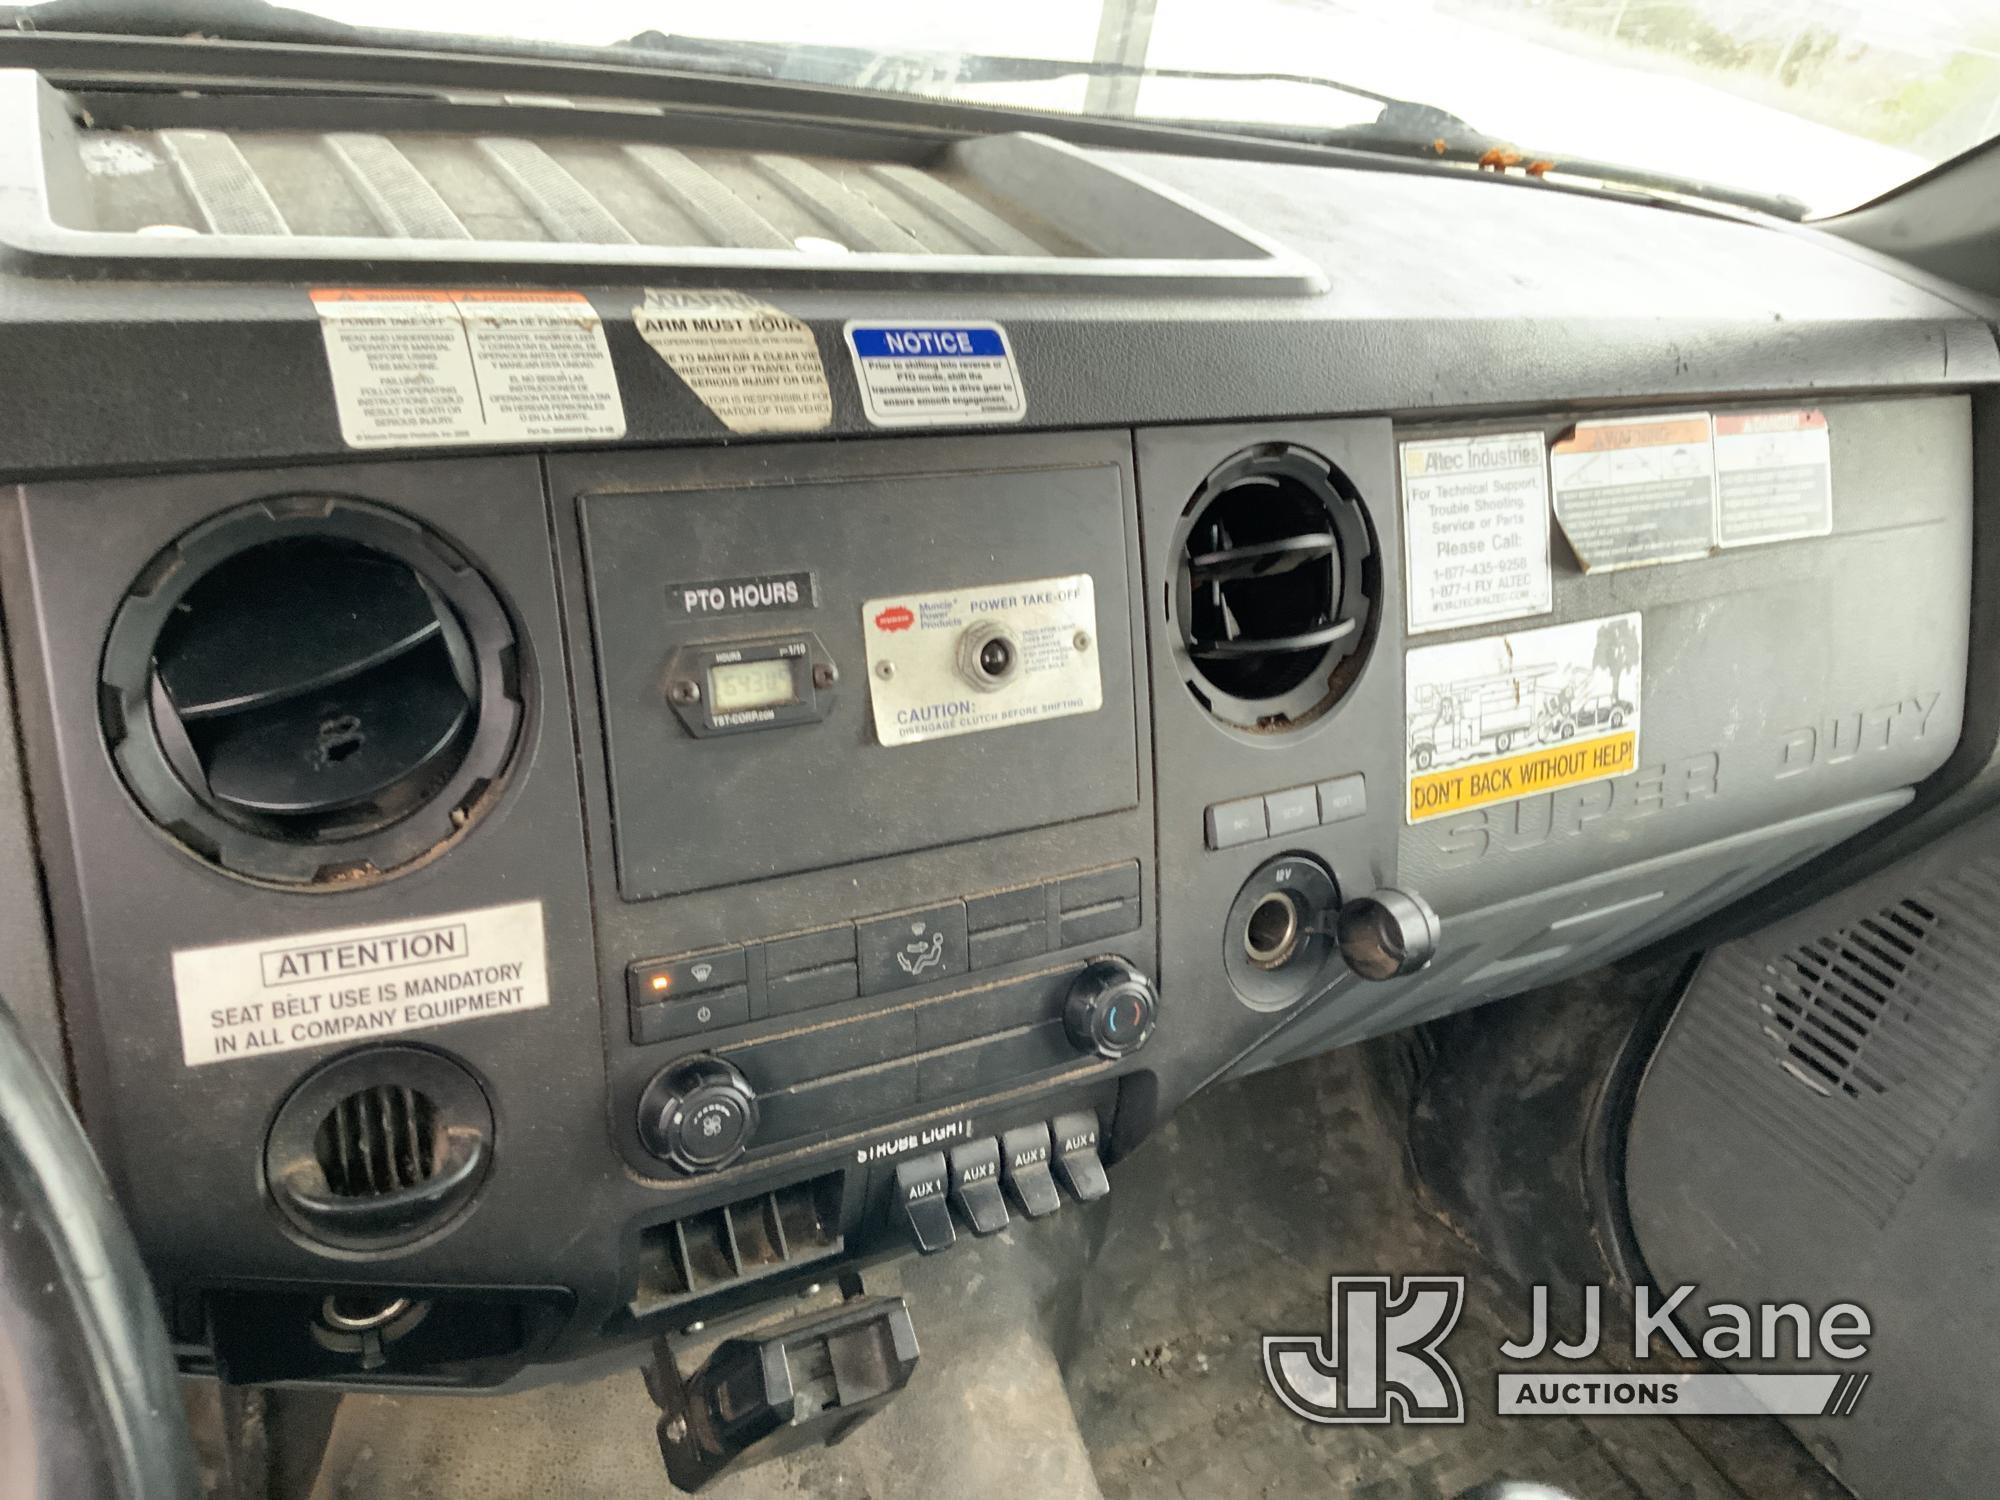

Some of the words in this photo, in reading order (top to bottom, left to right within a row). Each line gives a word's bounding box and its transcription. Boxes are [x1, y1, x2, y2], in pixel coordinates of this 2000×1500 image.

[692, 318, 743, 333] MUST
[392, 334, 455, 343] UNDERSTAND
[885, 331, 974, 355] NOTICE
[367, 353, 405, 362] BEFORE
[680, 352, 695, 363] TO
[697, 352, 750, 363] MAINTAIN
[753, 352, 761, 361] A
[763, 351, 799, 361] CLEAR
[868, 361, 891, 370] Prior
[893, 361, 904, 369] to
[905, 360, 939, 372] shifting
[940, 361, 958, 369] into
[959, 361, 991, 369] reverse
[993, 361, 1002, 369] or
[733, 364, 747, 374] OF
[752, 363, 791, 373] TRAVEL
[896, 372, 917, 382] PTO
[947, 372, 967, 382] shift
[968, 372, 983, 382] the
[690, 376, 740, 388] SERIOUS
[741, 375, 780, 386] INJURY
[783, 375, 799, 385] OR
[871, 385, 931, 395] transmission
[932, 385, 950, 394] into
[959, 384, 981, 393] drive
[982, 385, 1001, 395] gear
[1003, 383, 1013, 393] to
[357, 397, 428, 406] INSTRUCTIONS
[743, 392, 809, 404] RESPONSIBLE
[882, 398, 915, 407] ensure
[917, 396, 951, 406] smooth
[1424, 451, 1464, 473] Altec
[1468, 444, 1540, 469] Industries
[1411, 487, 1431, 502] For
[1435, 481, 1488, 499] Technical
[1429, 502, 1470, 518] Trouble
[1431, 519, 1475, 535] Service
[1480, 518, 1491, 529] or
[1496, 513, 1524, 527] Parts
[1436, 538, 1486, 558] Please
[1474, 577, 1495, 594] FLY
[1498, 573, 1532, 590] ALTEC
[684, 587, 725, 613] PTO
[730, 580, 799, 609] HOURS
[970, 597, 1018, 614] POWER
[1022, 588, 1081, 607] TAKE-OFF
[919, 611, 949, 622] Power
[919, 617, 962, 631] Products
[715, 650, 742, 663] HOURS
[897, 701, 976, 725] CAUTION:
[899, 721, 957, 738] DISENGAGE
[959, 713, 999, 728] CLUTCH
[1001, 706, 1039, 720] BEFORE
[1041, 697, 1084, 713] SHIFTING
[1413, 776, 1464, 811] DON'T
[1470, 767, 1513, 797] BACK
[1519, 749, 1588, 785] WITHOUT
[1592, 740, 1633, 770] HELP!
[1434, 750, 1721, 870] SUPER
[1775, 692, 1941, 780] DUTY
[278, 931, 456, 979] ATTENTION
[210, 1004, 264, 1030] SEAT
[271, 995, 322, 1020] BELT
[330, 987, 371, 1010] USE
[377, 983, 398, 1003] IS
[404, 962, 524, 998] MANDATORY
[214, 1034, 237, 1055] IN
[244, 1028, 281, 1050] ALL
[291, 1009, 397, 1042] COMPANY
[404, 986, 526, 1024] EQUIPMENT
[1065, 1135, 1089, 1151] AUX
[1089, 1131, 1096, 1144] 4
[1015, 1150, 1039, 1167] AUX
[963, 1165, 987, 1182] AUX
[988, 1161, 996, 1174] 2
[908, 1182, 935, 1199] AUX
[936, 1178, 942, 1191] 1
